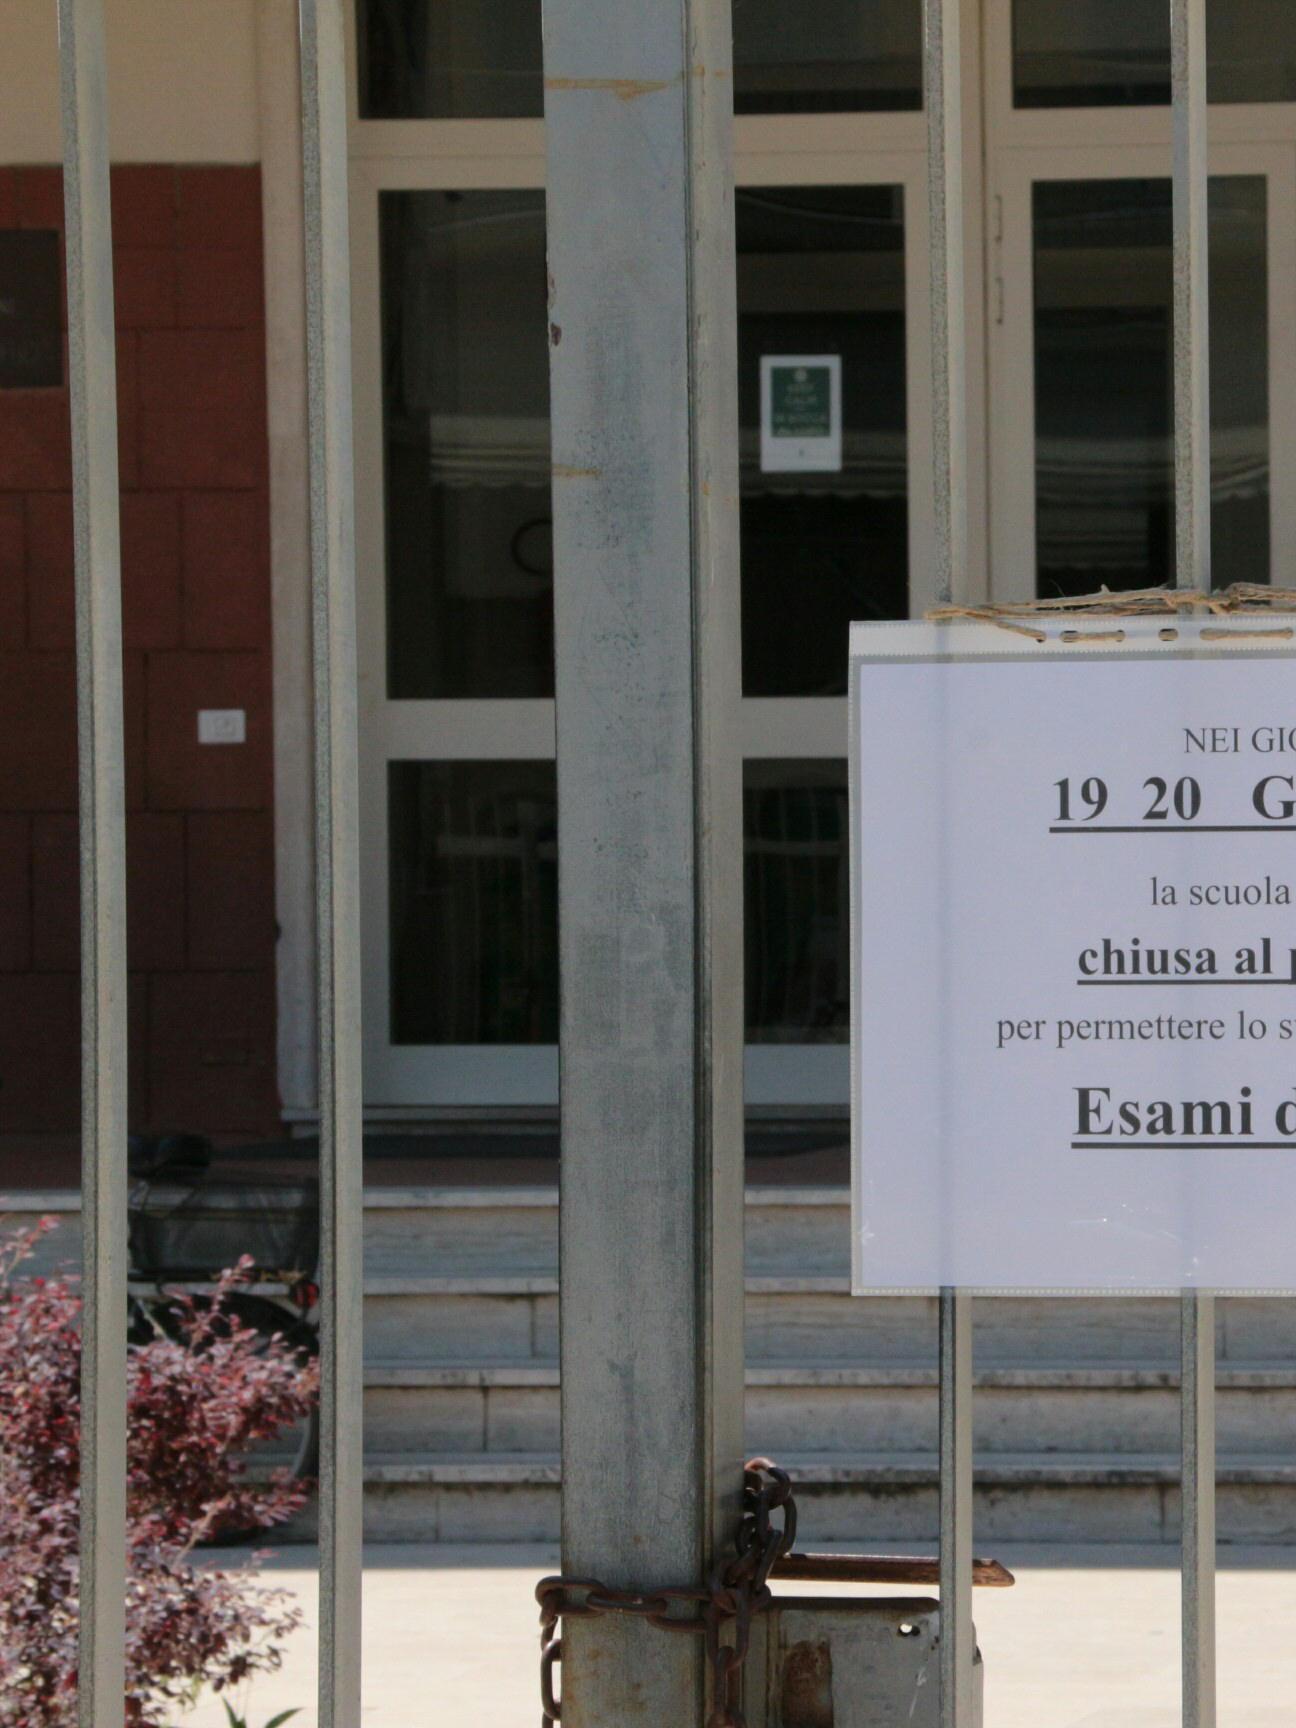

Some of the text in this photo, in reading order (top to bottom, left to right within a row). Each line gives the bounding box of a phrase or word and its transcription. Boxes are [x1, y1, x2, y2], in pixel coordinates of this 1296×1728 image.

[1183, 727, 1240, 753] NEI
[1053, 776, 1109, 822] 19
[1142, 776, 1202, 821] 20
[1151, 876, 1178, 906] la
[1189, 875, 1291, 906] scuola
[1078, 937, 1219, 976] chiusa
[1234, 937, 1273, 975] al
[996, 1019, 1047, 1049] per
[1056, 1015, 1225, 1049] permettere
[1238, 1010, 1267, 1040] lo
[1072, 1085, 1255, 1137] Esami
